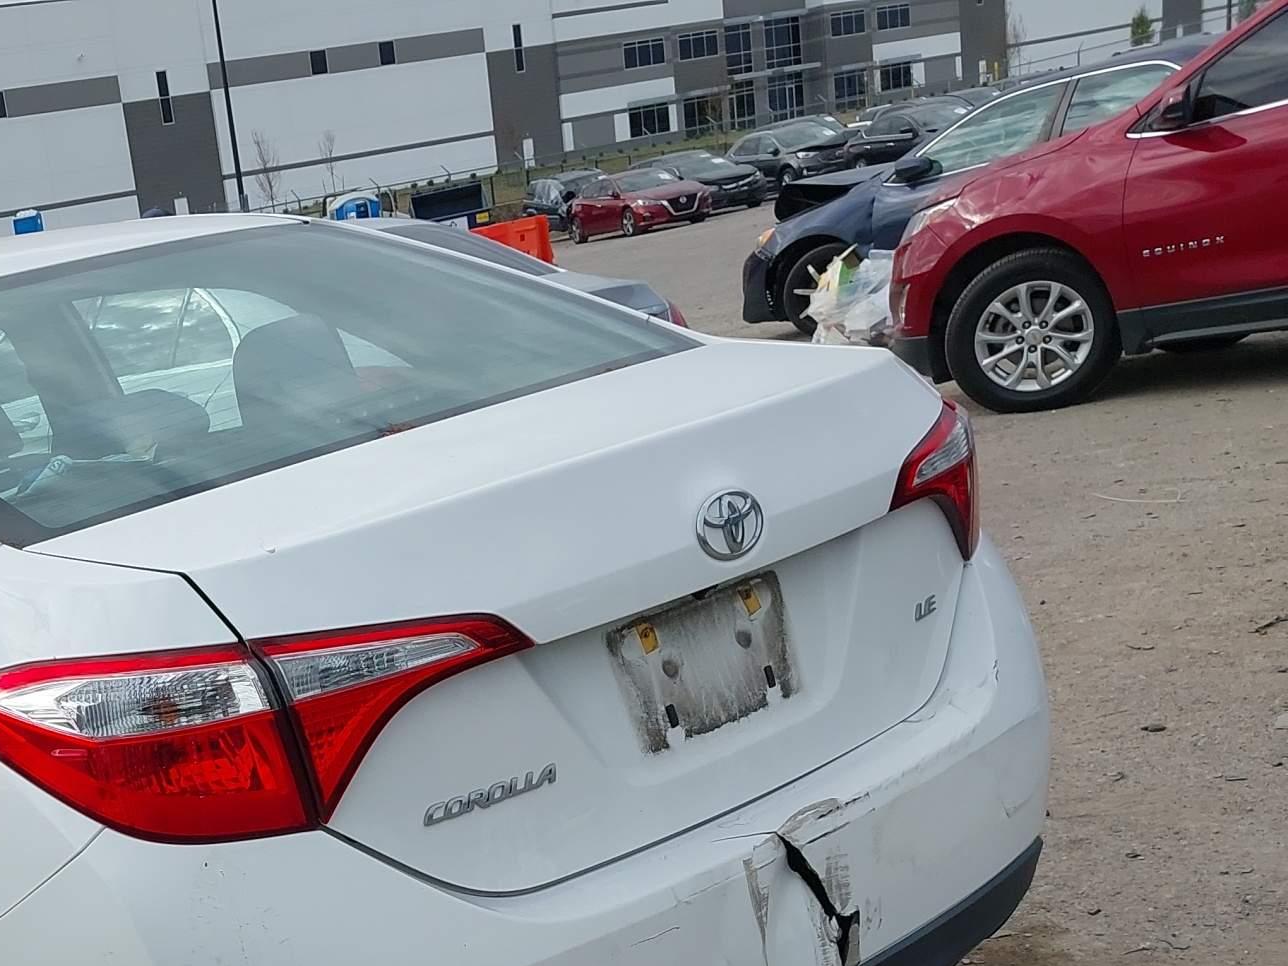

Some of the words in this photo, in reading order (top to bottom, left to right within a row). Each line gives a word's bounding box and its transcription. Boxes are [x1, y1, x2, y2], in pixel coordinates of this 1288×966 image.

[1142, 235, 1225, 257] EQUINOX
[915, 594, 937, 622] LE
[423, 762, 557, 827] COROLLA
